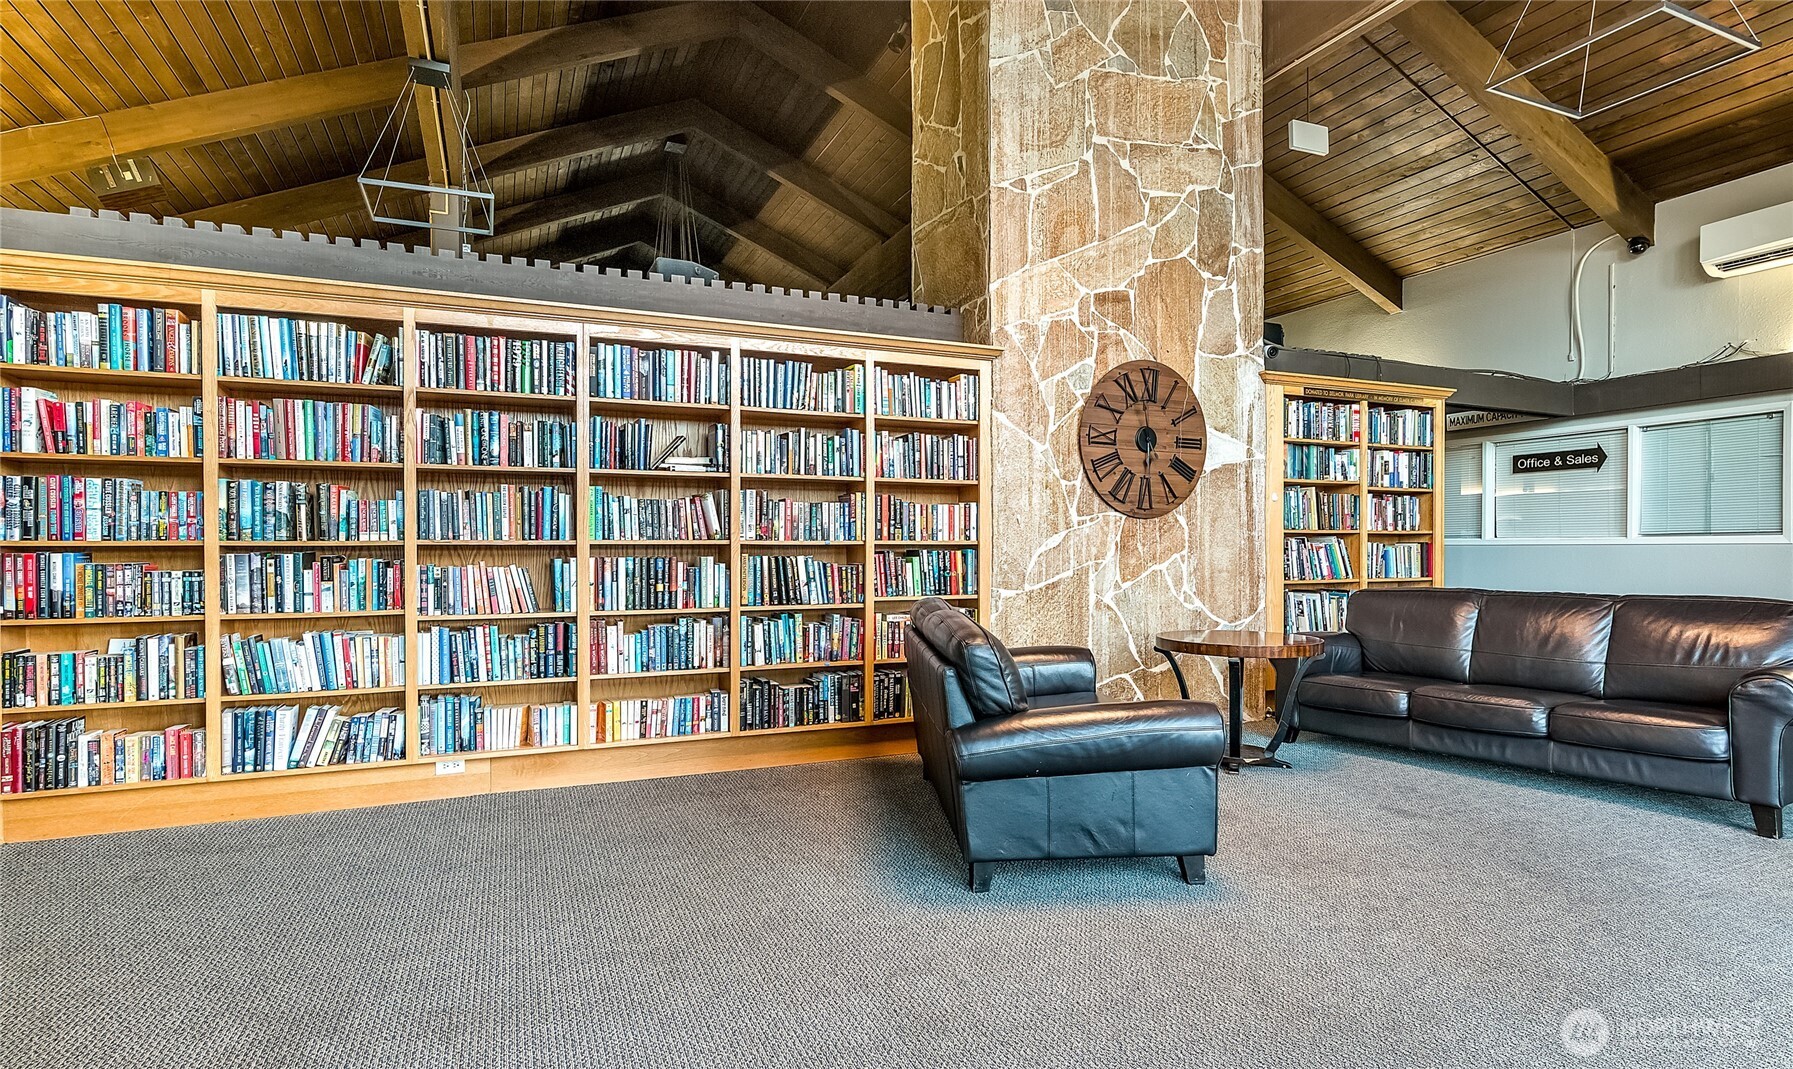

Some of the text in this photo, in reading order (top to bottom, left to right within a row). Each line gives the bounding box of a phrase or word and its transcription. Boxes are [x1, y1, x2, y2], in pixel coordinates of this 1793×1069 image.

[512, 342, 522, 367] 1979
[1449, 412, 1523, 427] MAXIMUM CAPACI
[1518, 454, 1599, 469] Office & Sales
[105, 480, 113, 514] CLIVE CUSSLER
[277, 713, 286, 730] Purity
